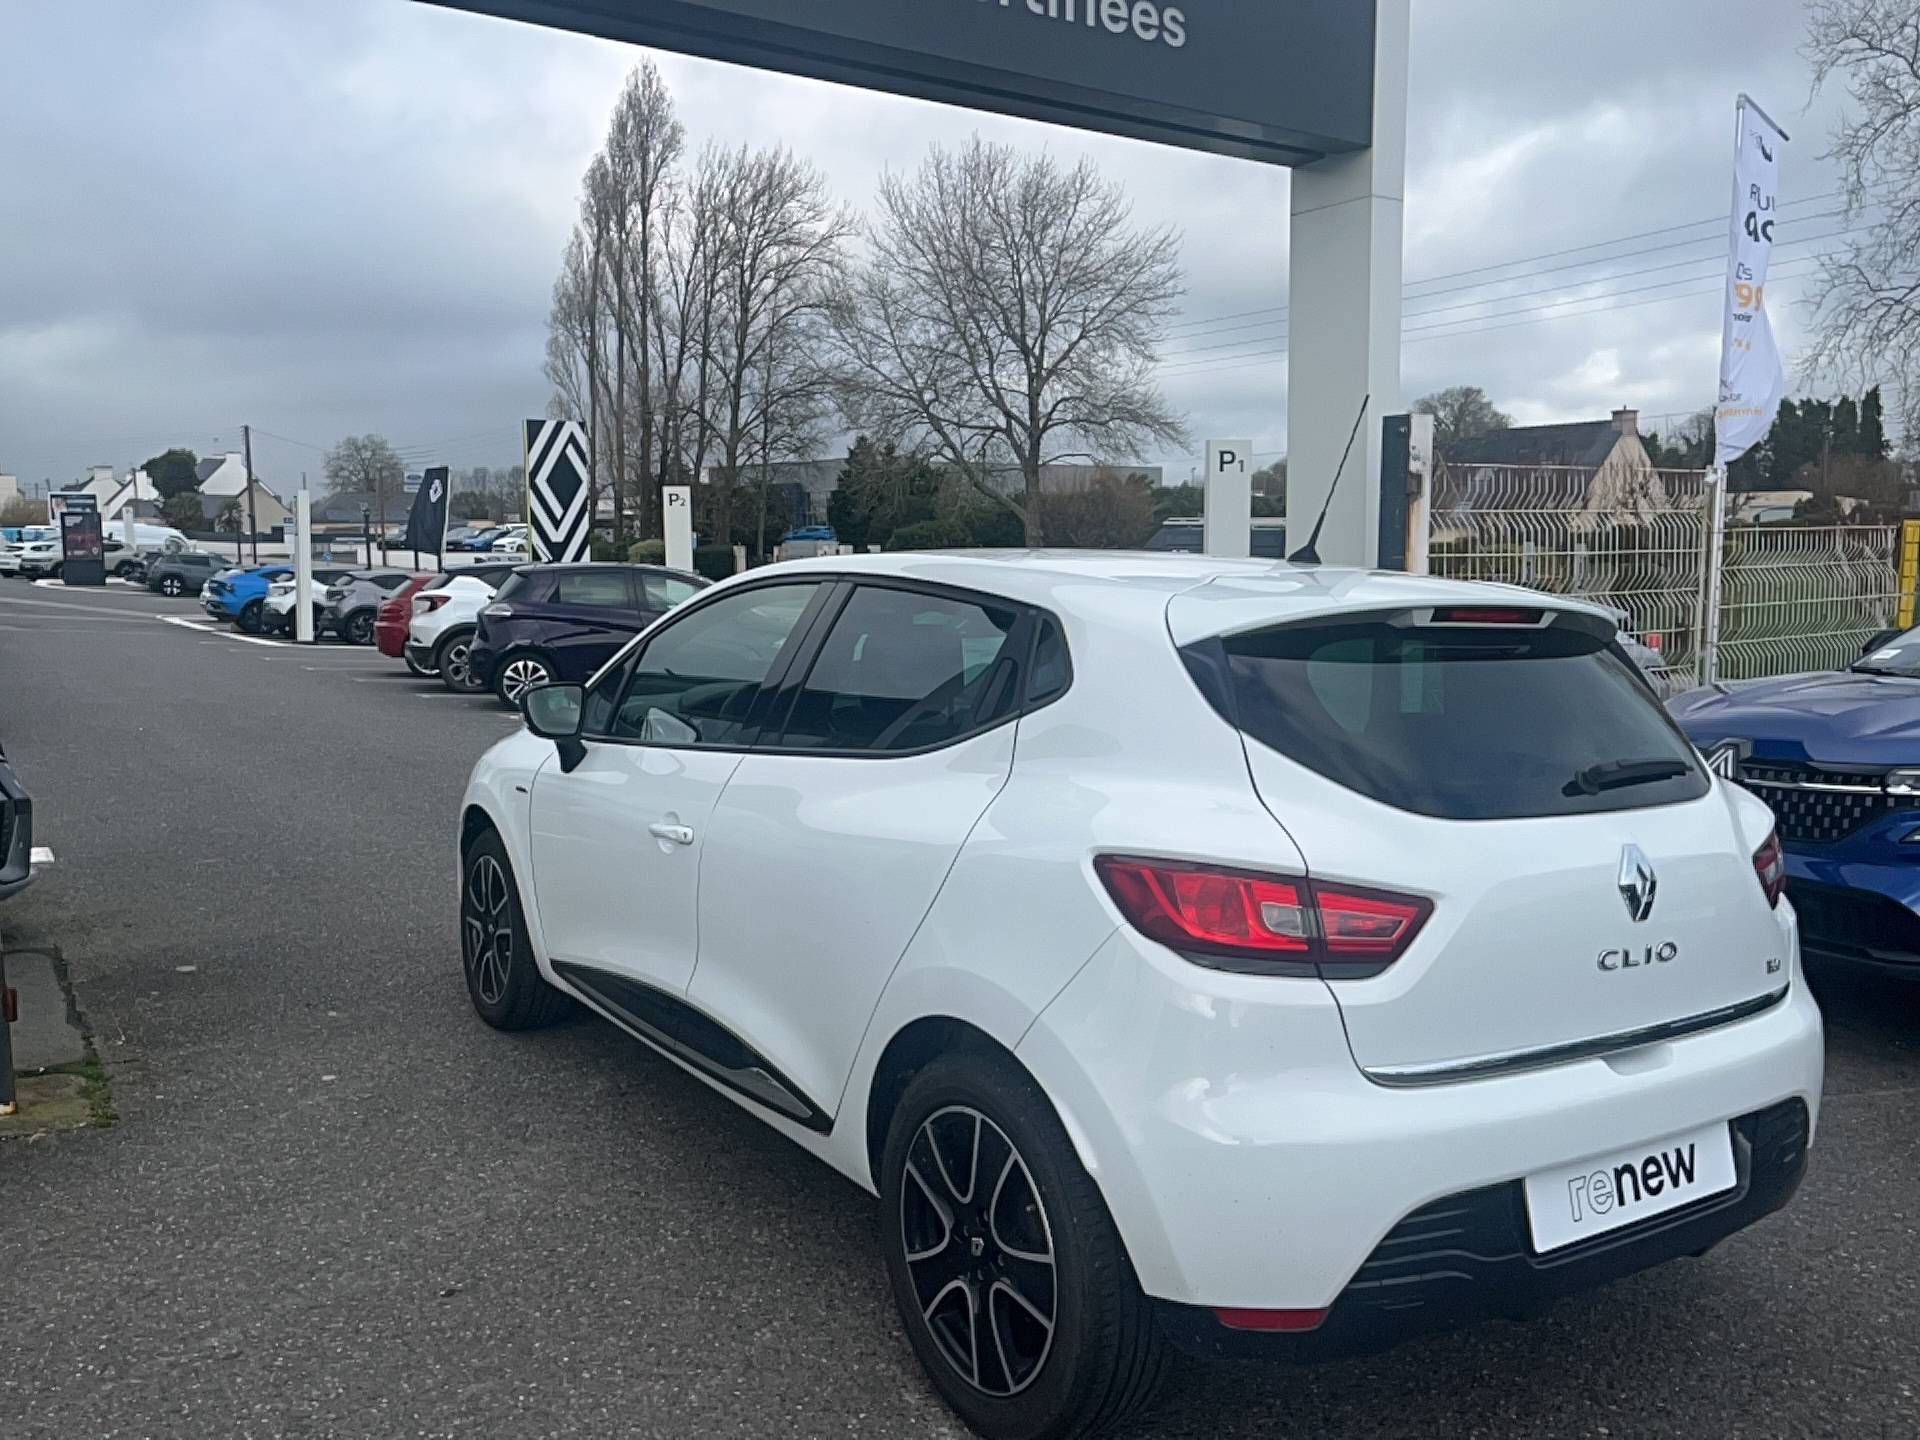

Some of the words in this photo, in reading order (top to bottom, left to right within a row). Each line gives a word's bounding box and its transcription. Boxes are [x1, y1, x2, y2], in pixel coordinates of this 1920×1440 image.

[1219, 450, 1244, 472] P1
[668, 493, 686, 507] P2
[1597, 941, 1677, 971] CLIO
[1568, 1143, 1695, 1223] renew
